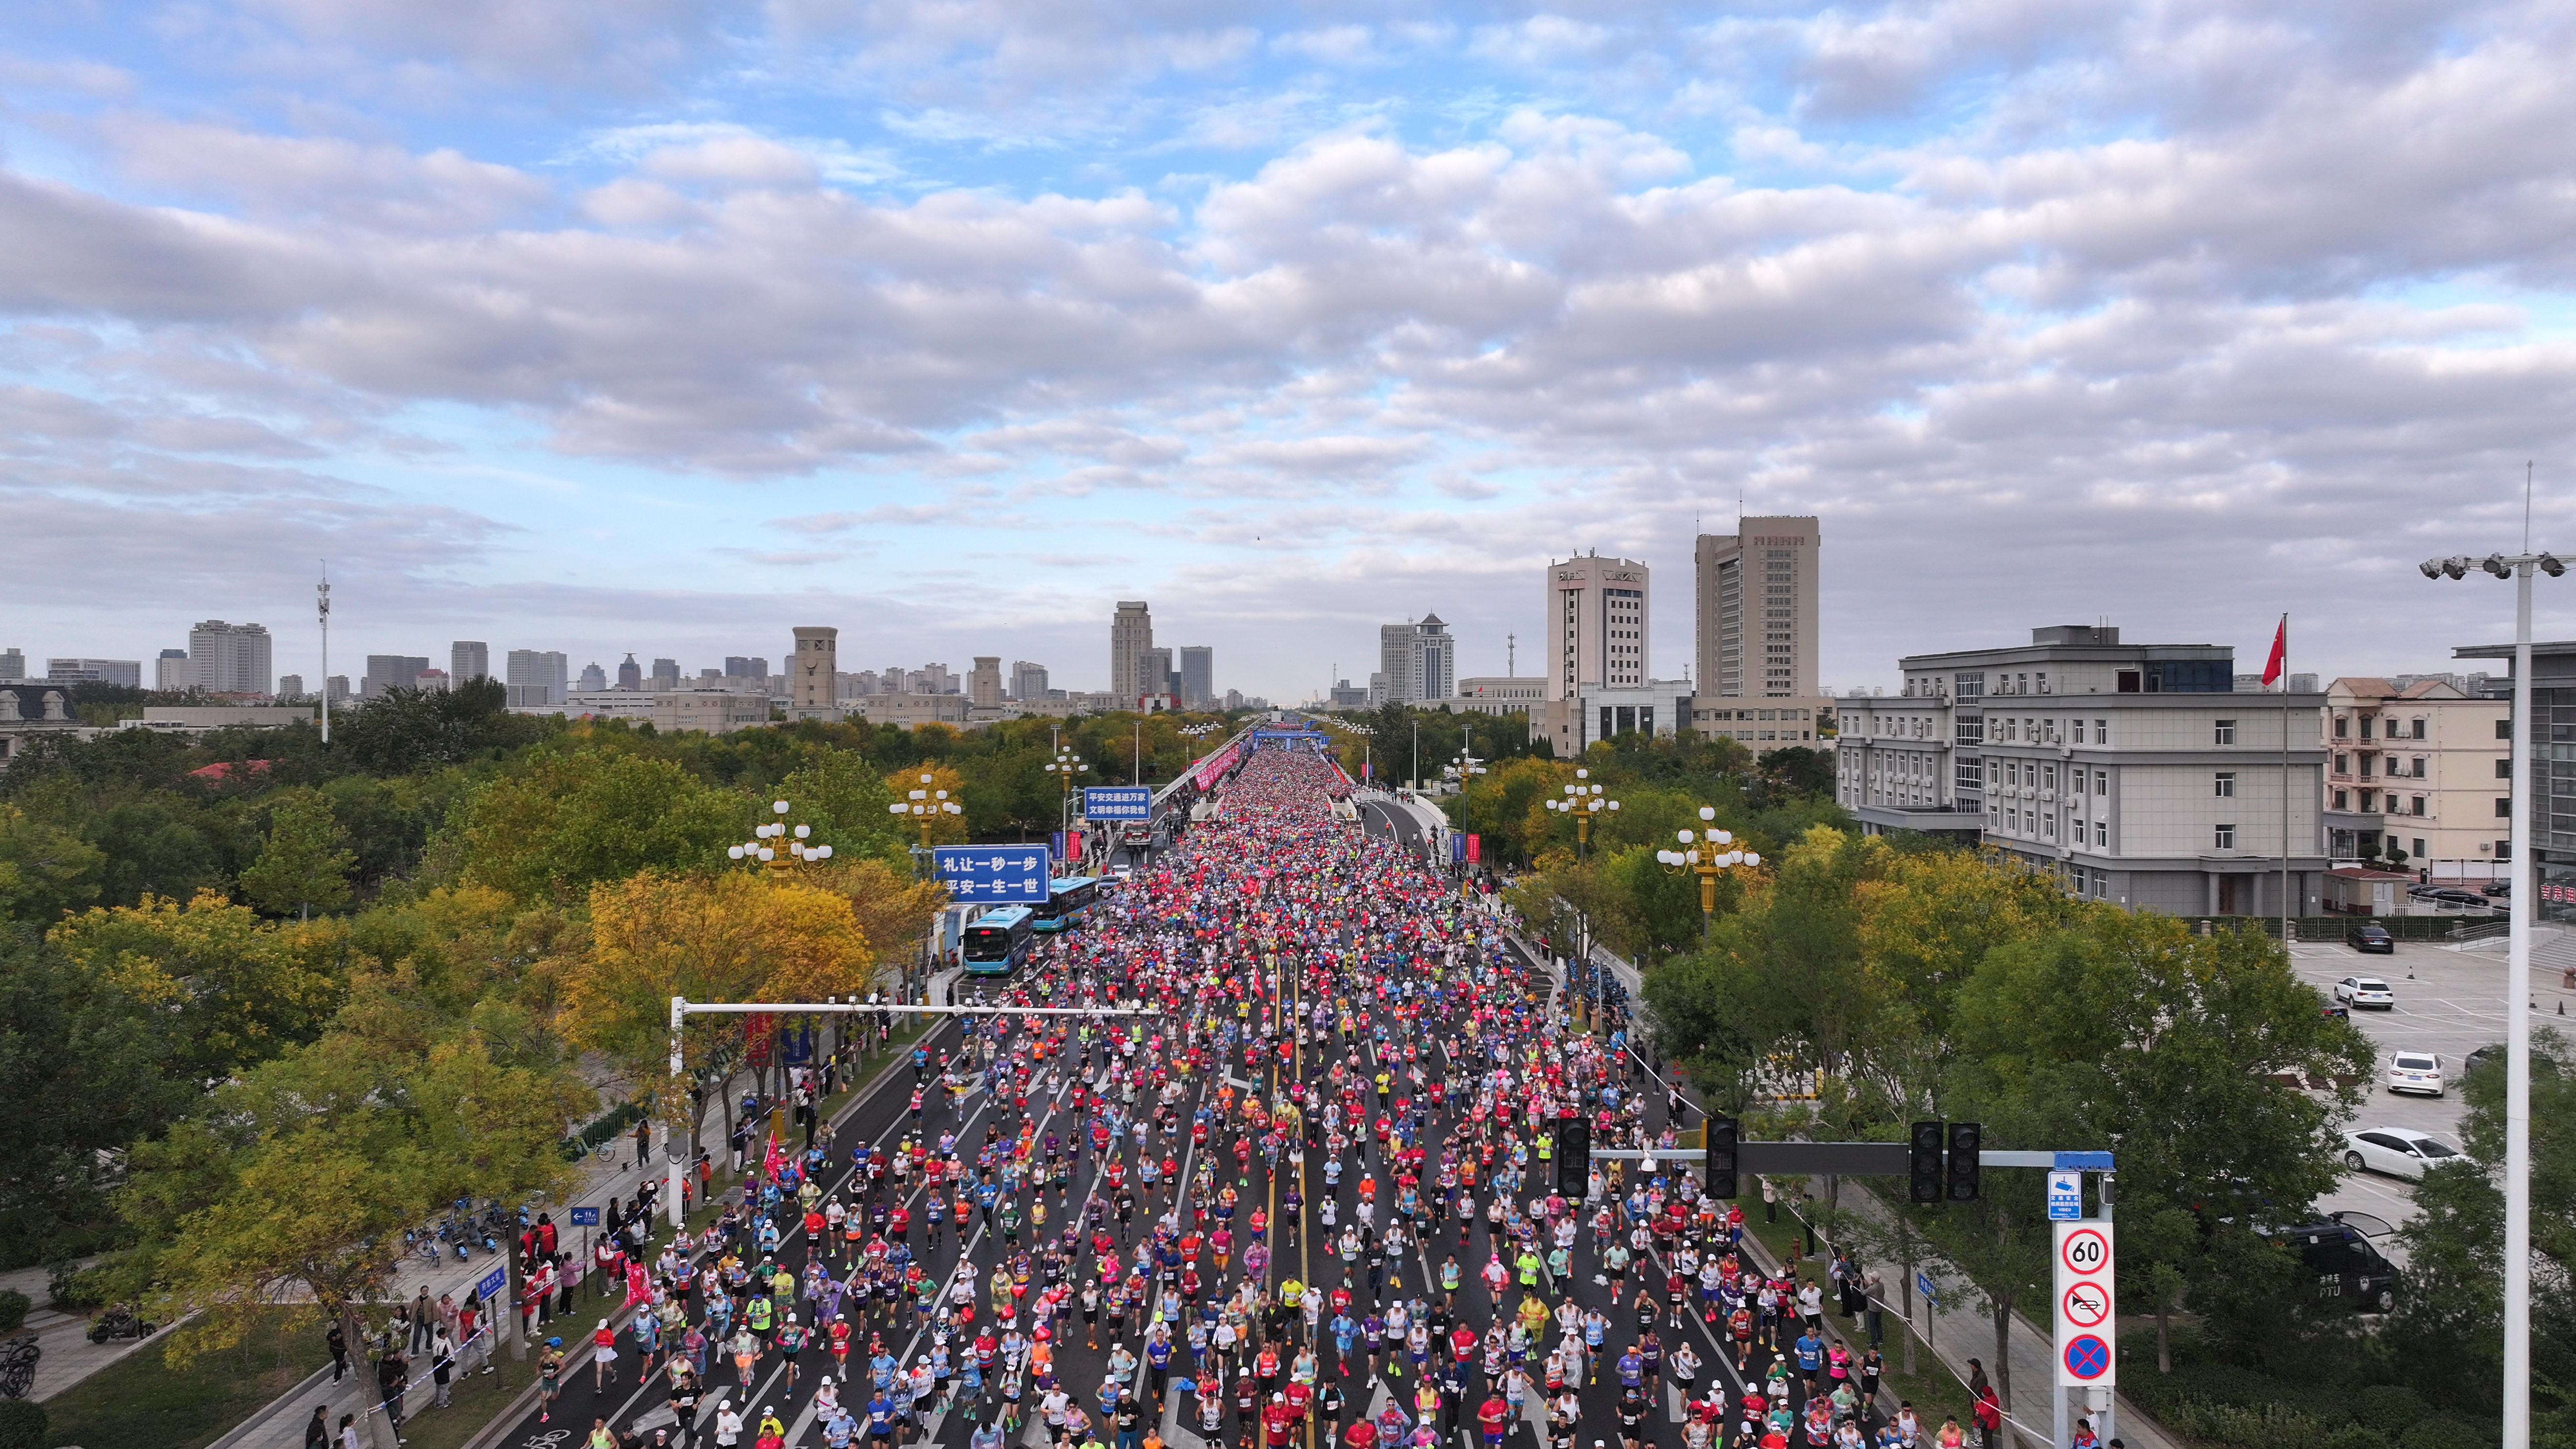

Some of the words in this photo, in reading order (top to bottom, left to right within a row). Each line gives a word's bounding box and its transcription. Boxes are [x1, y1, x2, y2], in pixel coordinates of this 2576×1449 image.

[1089, 793, 1146, 802] 平安交通进万家
[1089, 805, 1146, 814] 文明幸福你我他
[944, 856, 1037, 871] 礼让一秒一步
[946, 878, 1038, 894] 平安一生一世
[2073, 1242, 2099, 1263] 60
[2320, 1286, 2340, 1298] PTU
